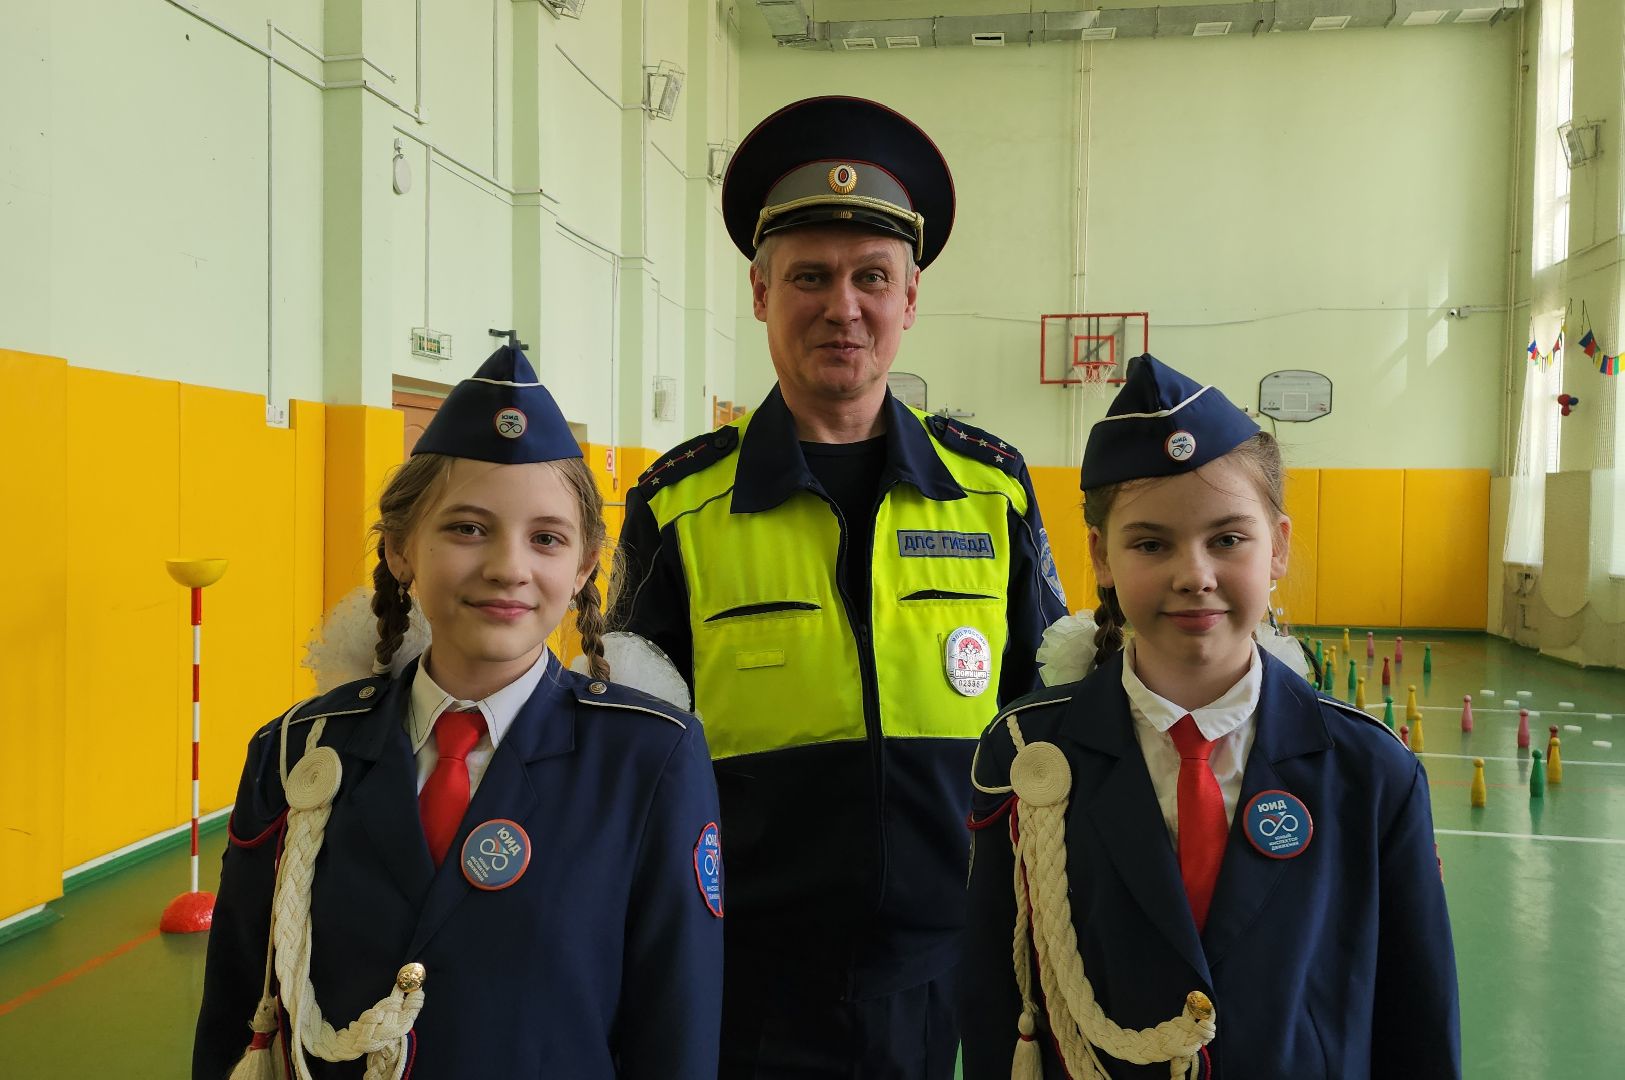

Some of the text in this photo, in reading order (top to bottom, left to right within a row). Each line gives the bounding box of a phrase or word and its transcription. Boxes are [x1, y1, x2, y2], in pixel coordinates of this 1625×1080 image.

[1172, 436, 1188, 444] ЮИД
[904, 535, 990, 553] ДПС ГИБДД
[1257, 799, 1288, 813] ЮИД
[496, 826, 522, 857] ЮИД
